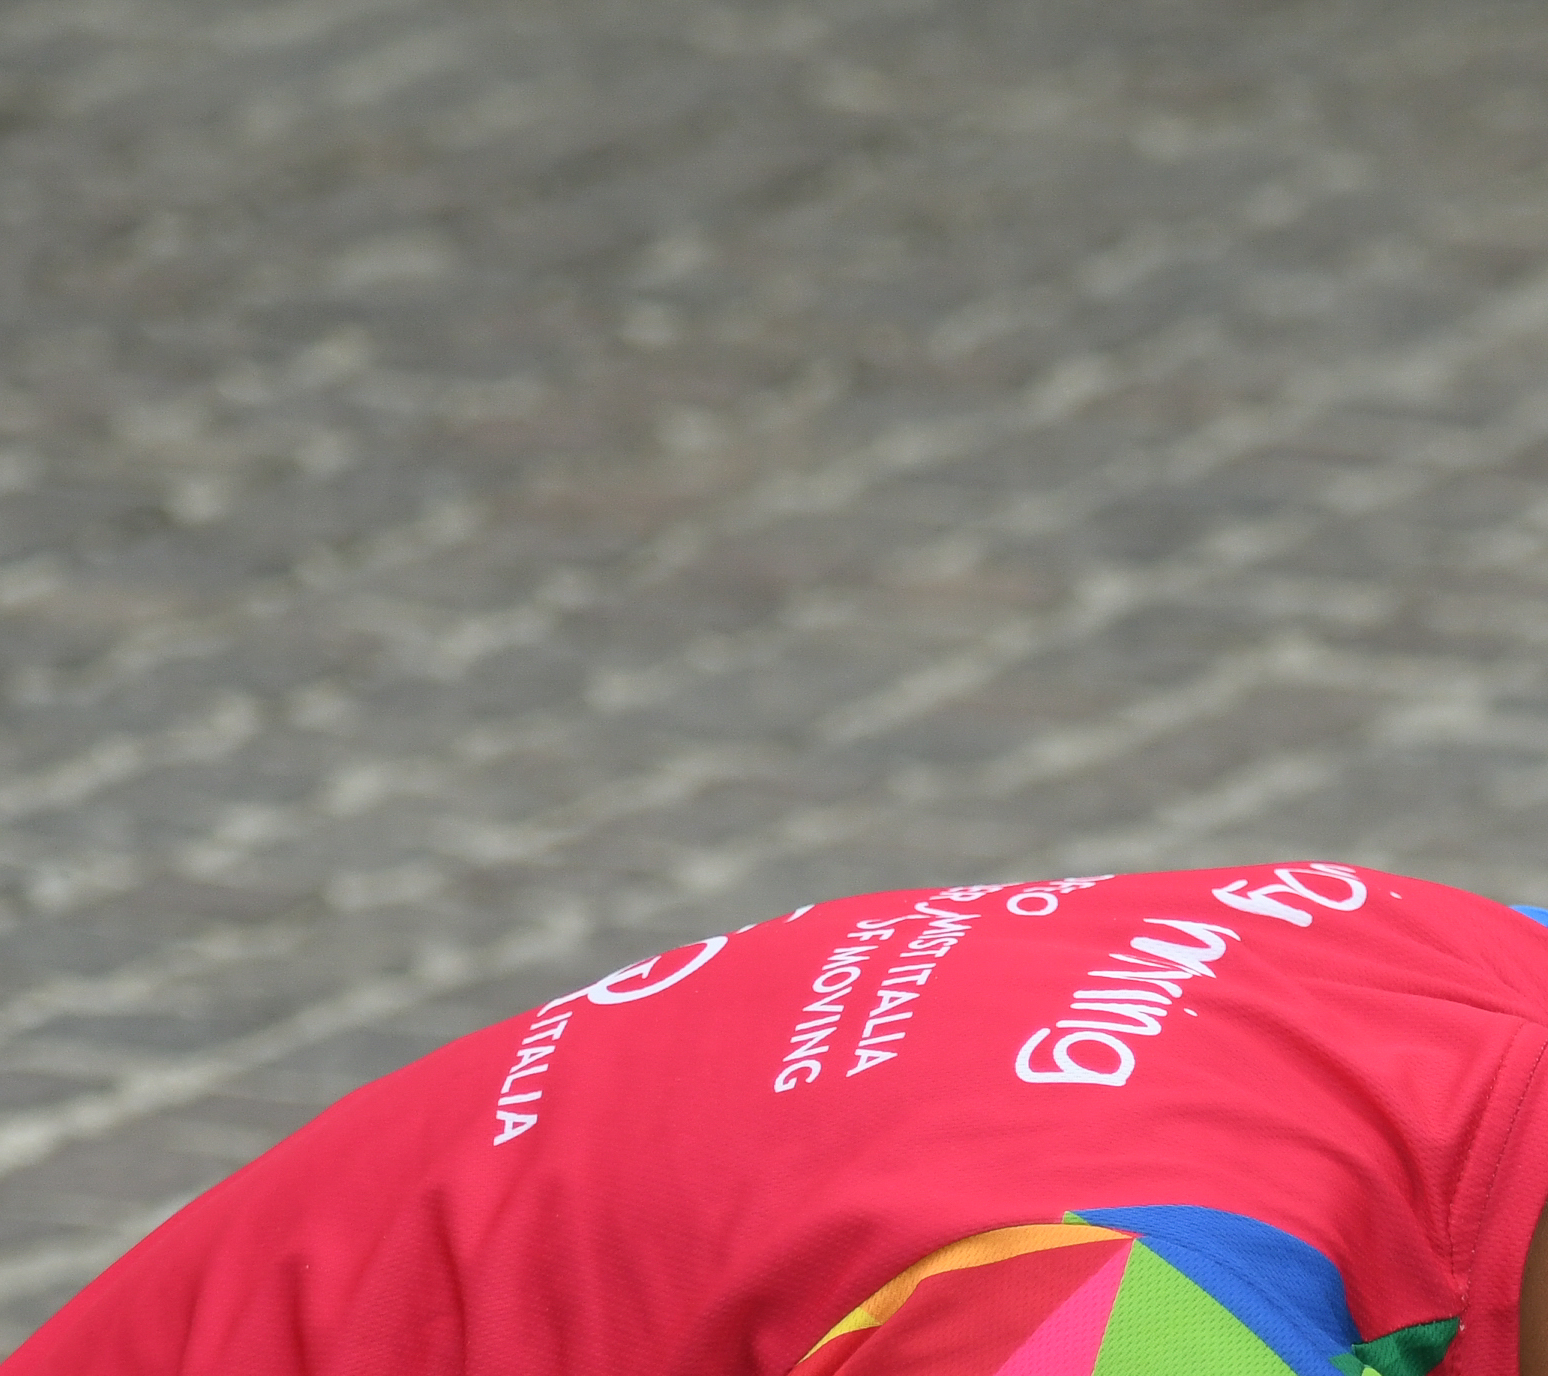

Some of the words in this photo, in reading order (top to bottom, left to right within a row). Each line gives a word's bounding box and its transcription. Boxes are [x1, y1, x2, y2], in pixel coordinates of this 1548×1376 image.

[493, 1010, 574, 1147] ITALIA
[774, 945, 880, 1094] MOVING
[845, 961, 938, 1079] ITALIA
